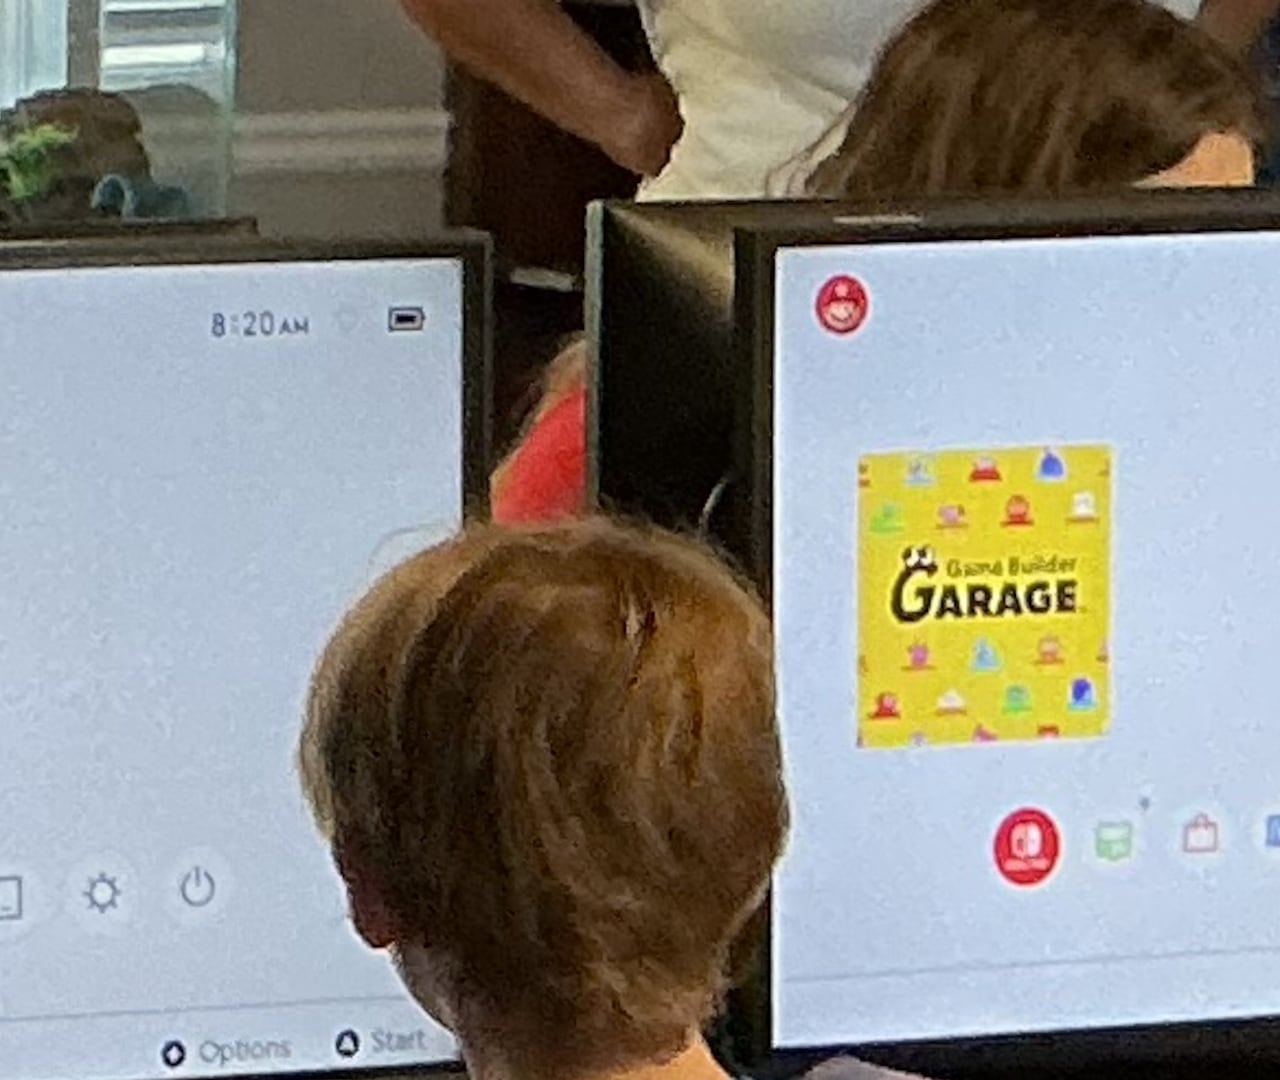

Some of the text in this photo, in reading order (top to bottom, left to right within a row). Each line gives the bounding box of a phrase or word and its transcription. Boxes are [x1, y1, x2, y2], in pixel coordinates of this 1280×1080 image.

[946, 559, 1003, 578] Game
[890, 563, 1078, 623] GARAGE
[199, 1039, 293, 1066] Options
[370, 1028, 427, 1053] Start
